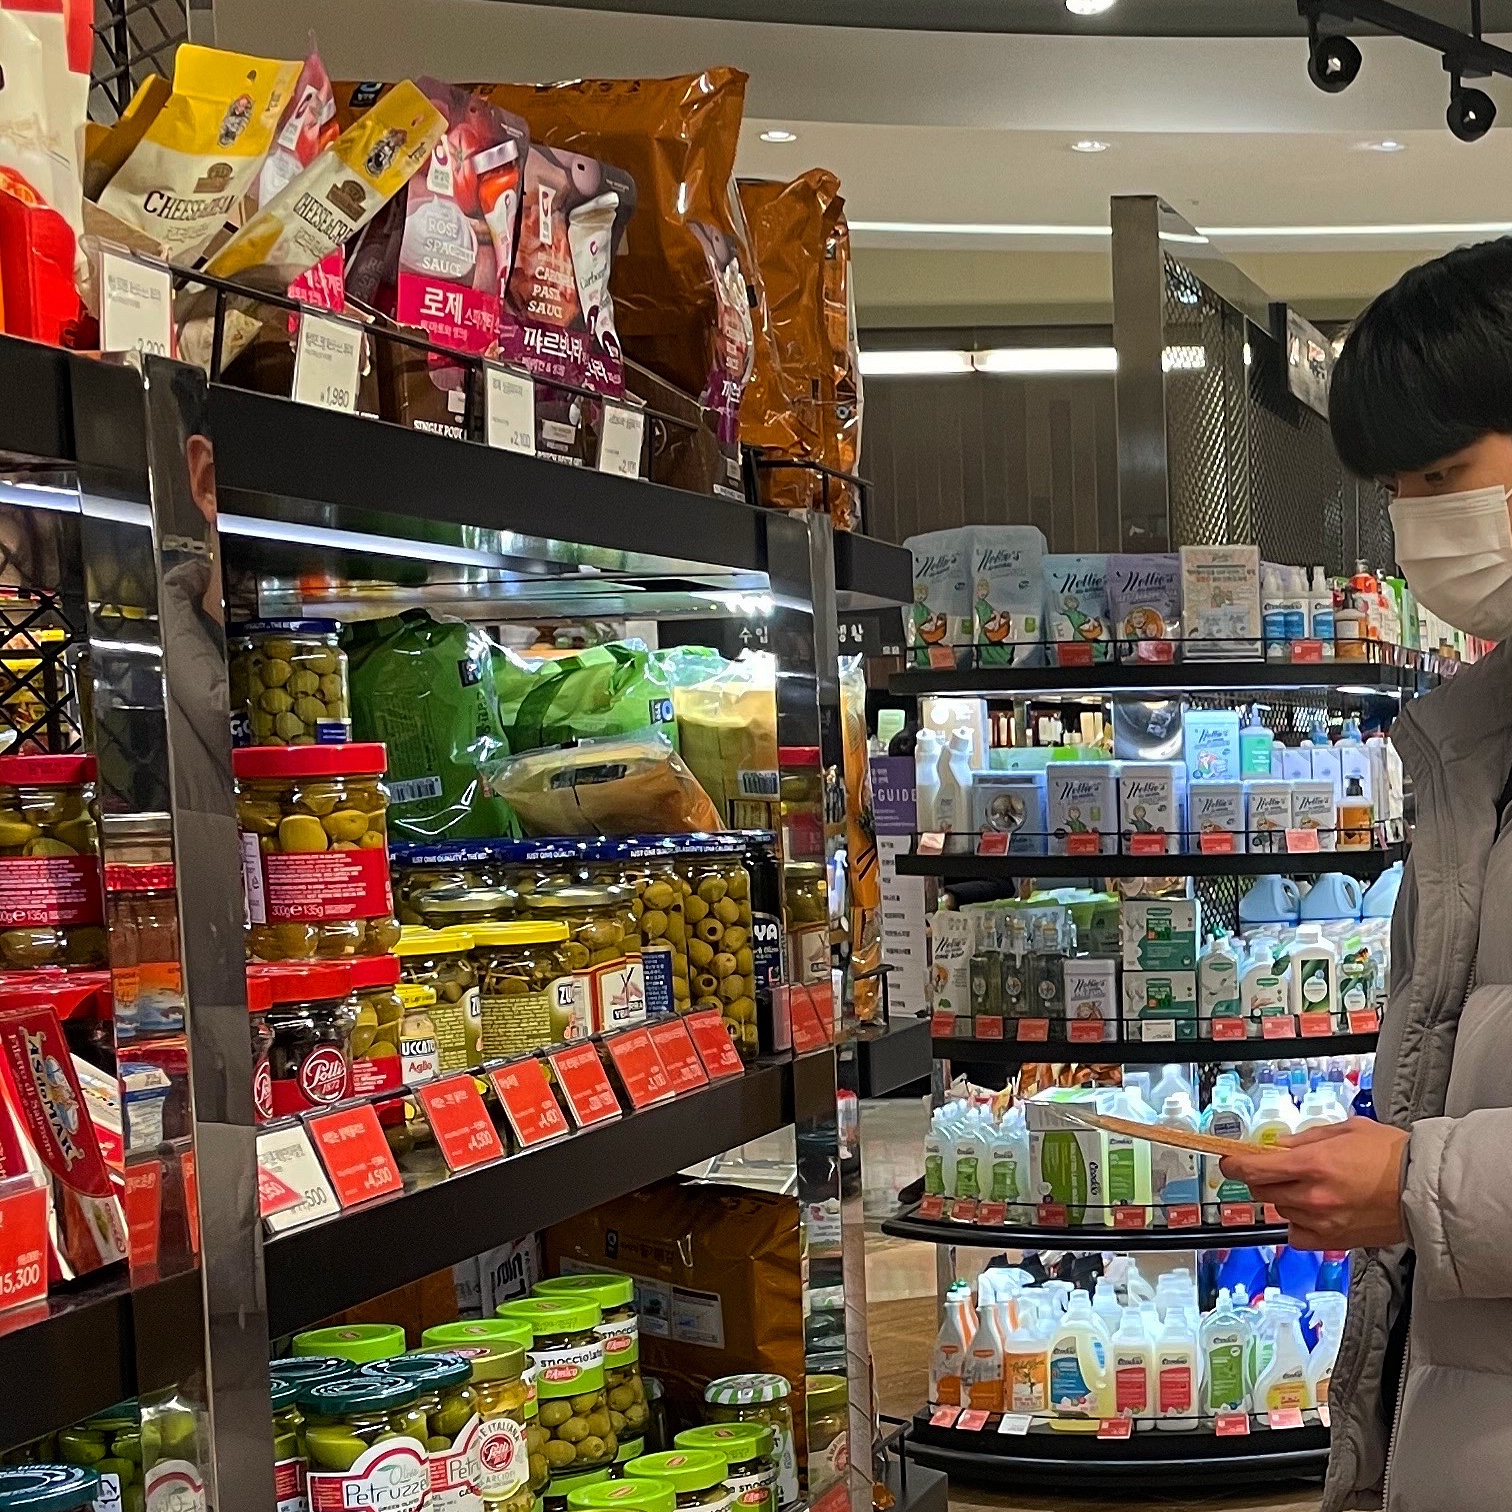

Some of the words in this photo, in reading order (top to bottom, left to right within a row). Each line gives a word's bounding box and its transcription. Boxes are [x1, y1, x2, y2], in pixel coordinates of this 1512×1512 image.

[420, 286, 464, 326] 로제
[872, 788, 917, 802] -GUIDE
[401, 1039, 435, 1056] UCCATO
[305, 1059, 346, 1090] Polli
